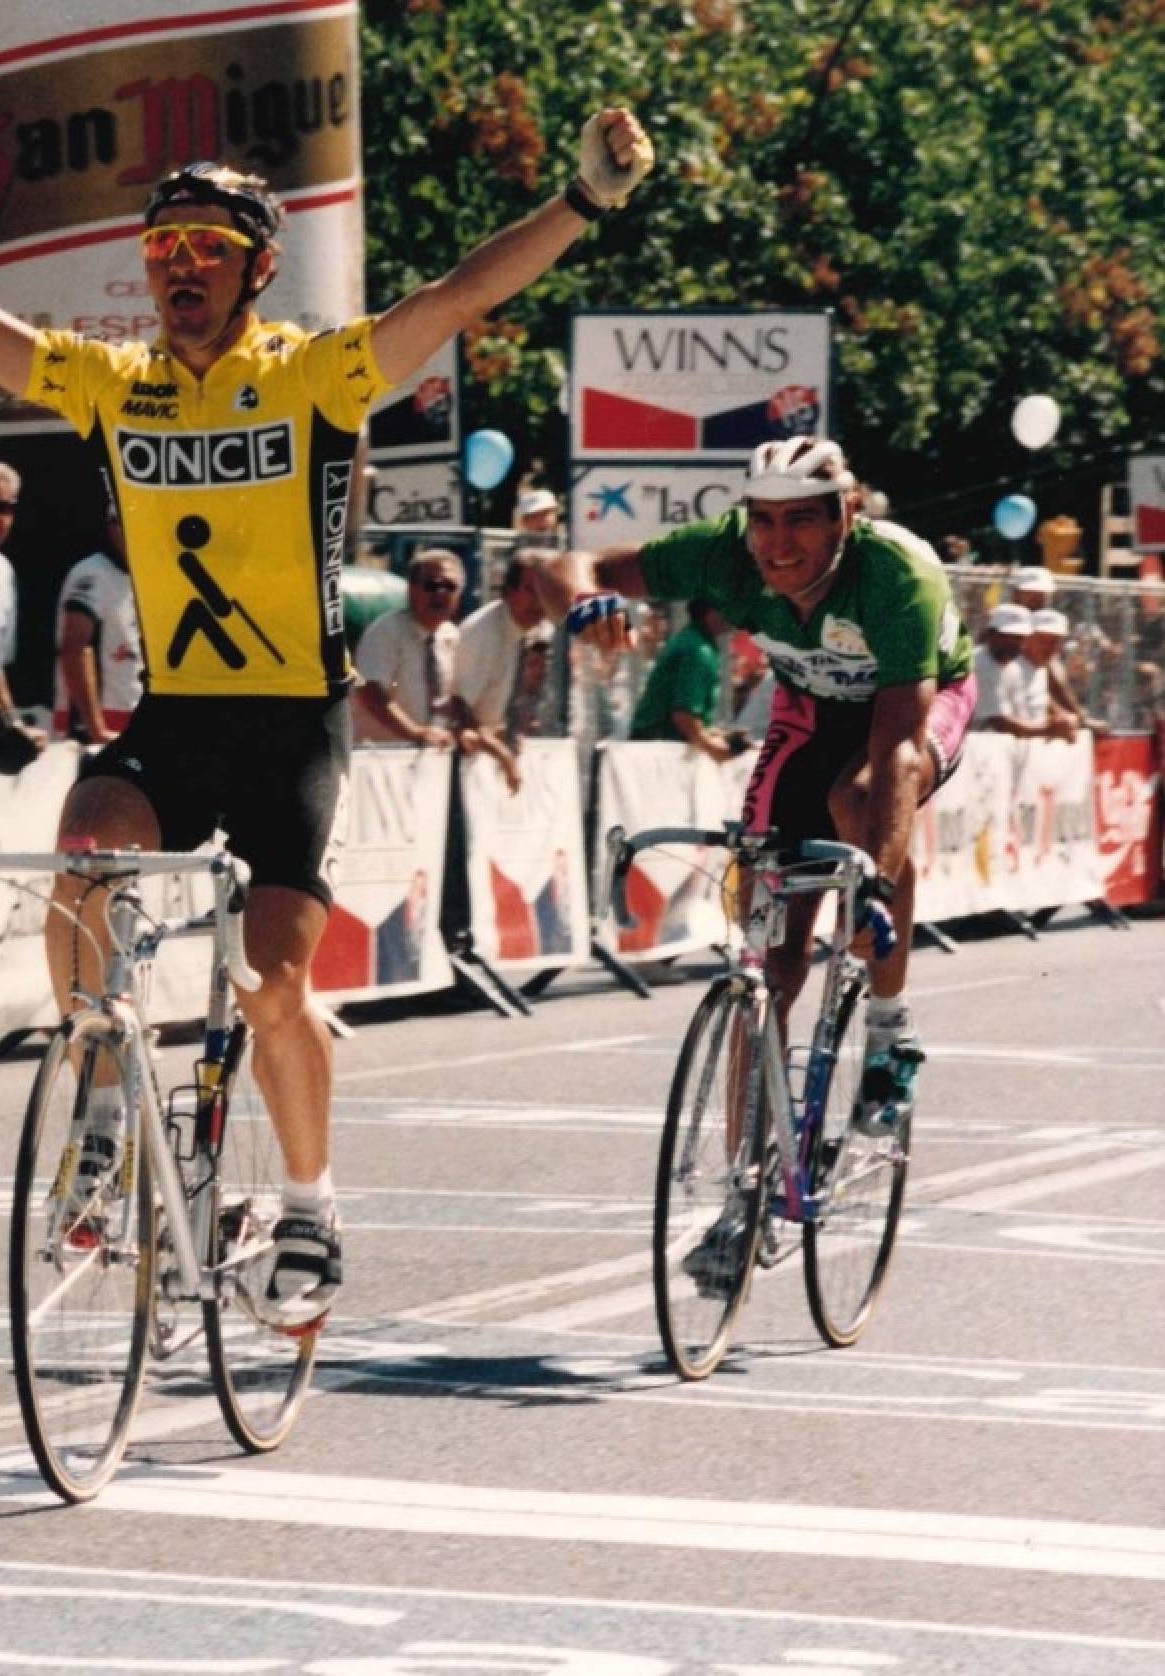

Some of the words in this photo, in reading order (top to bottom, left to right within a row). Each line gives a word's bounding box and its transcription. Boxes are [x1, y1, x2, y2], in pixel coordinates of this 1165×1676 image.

[612, 327, 790, 373] WINNS
[120, 400, 180, 420] MAVIC
[122, 428, 290, 483] ONCE
